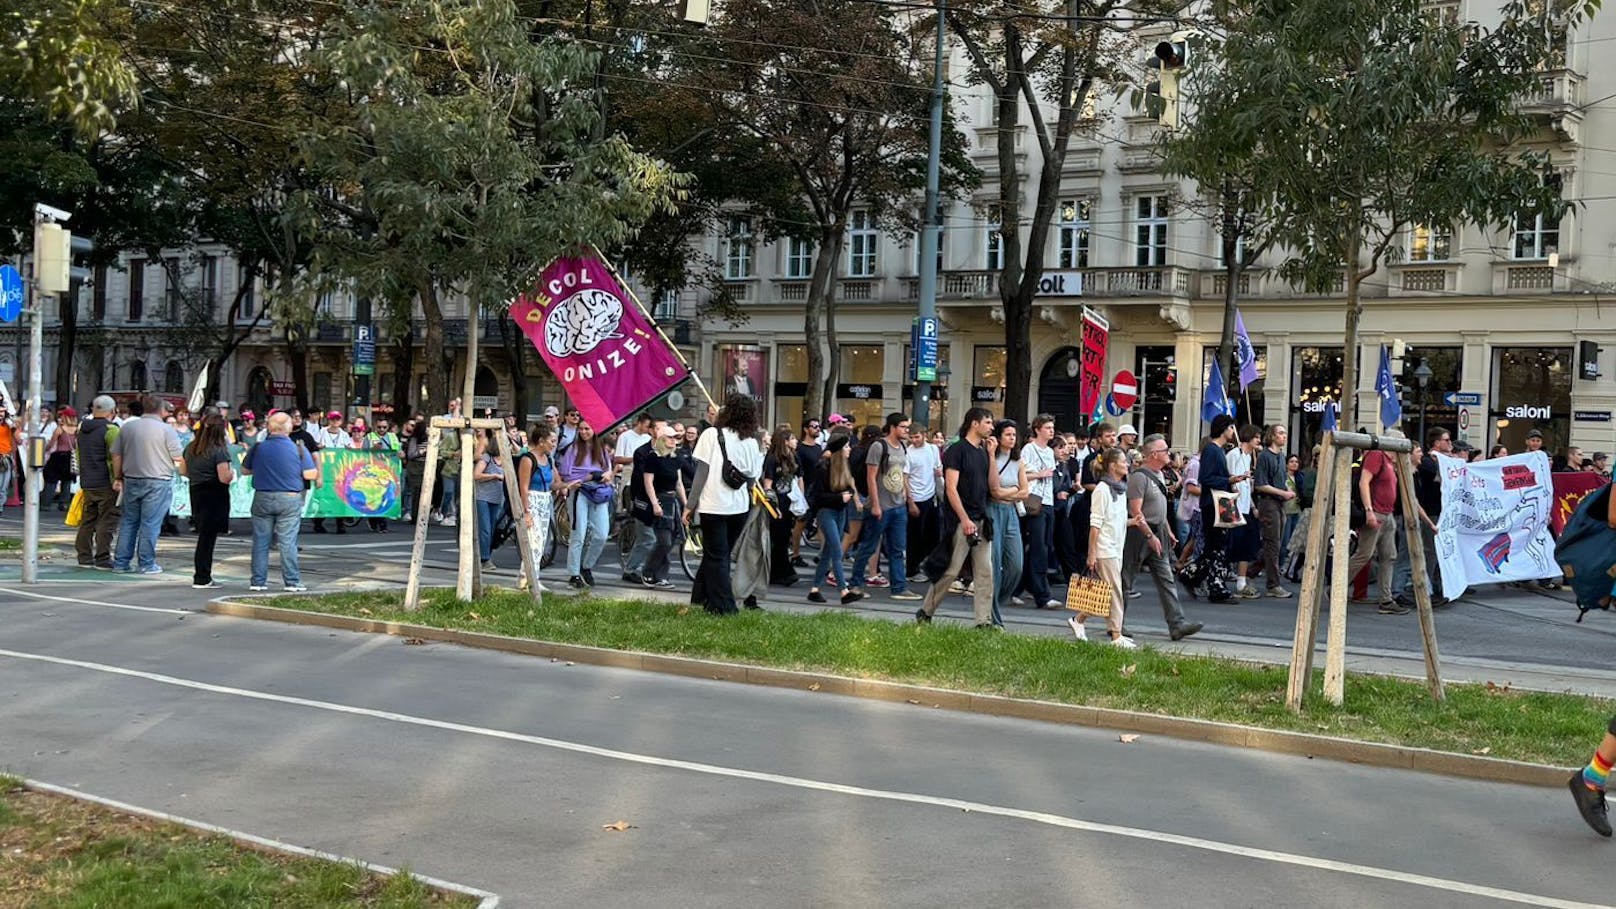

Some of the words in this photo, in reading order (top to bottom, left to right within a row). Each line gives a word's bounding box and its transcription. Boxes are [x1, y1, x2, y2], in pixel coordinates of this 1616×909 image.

[526, 269, 593, 323] DECOL
[1039, 274, 1065, 294] olt
[564, 328, 651, 382] ONIZE!
